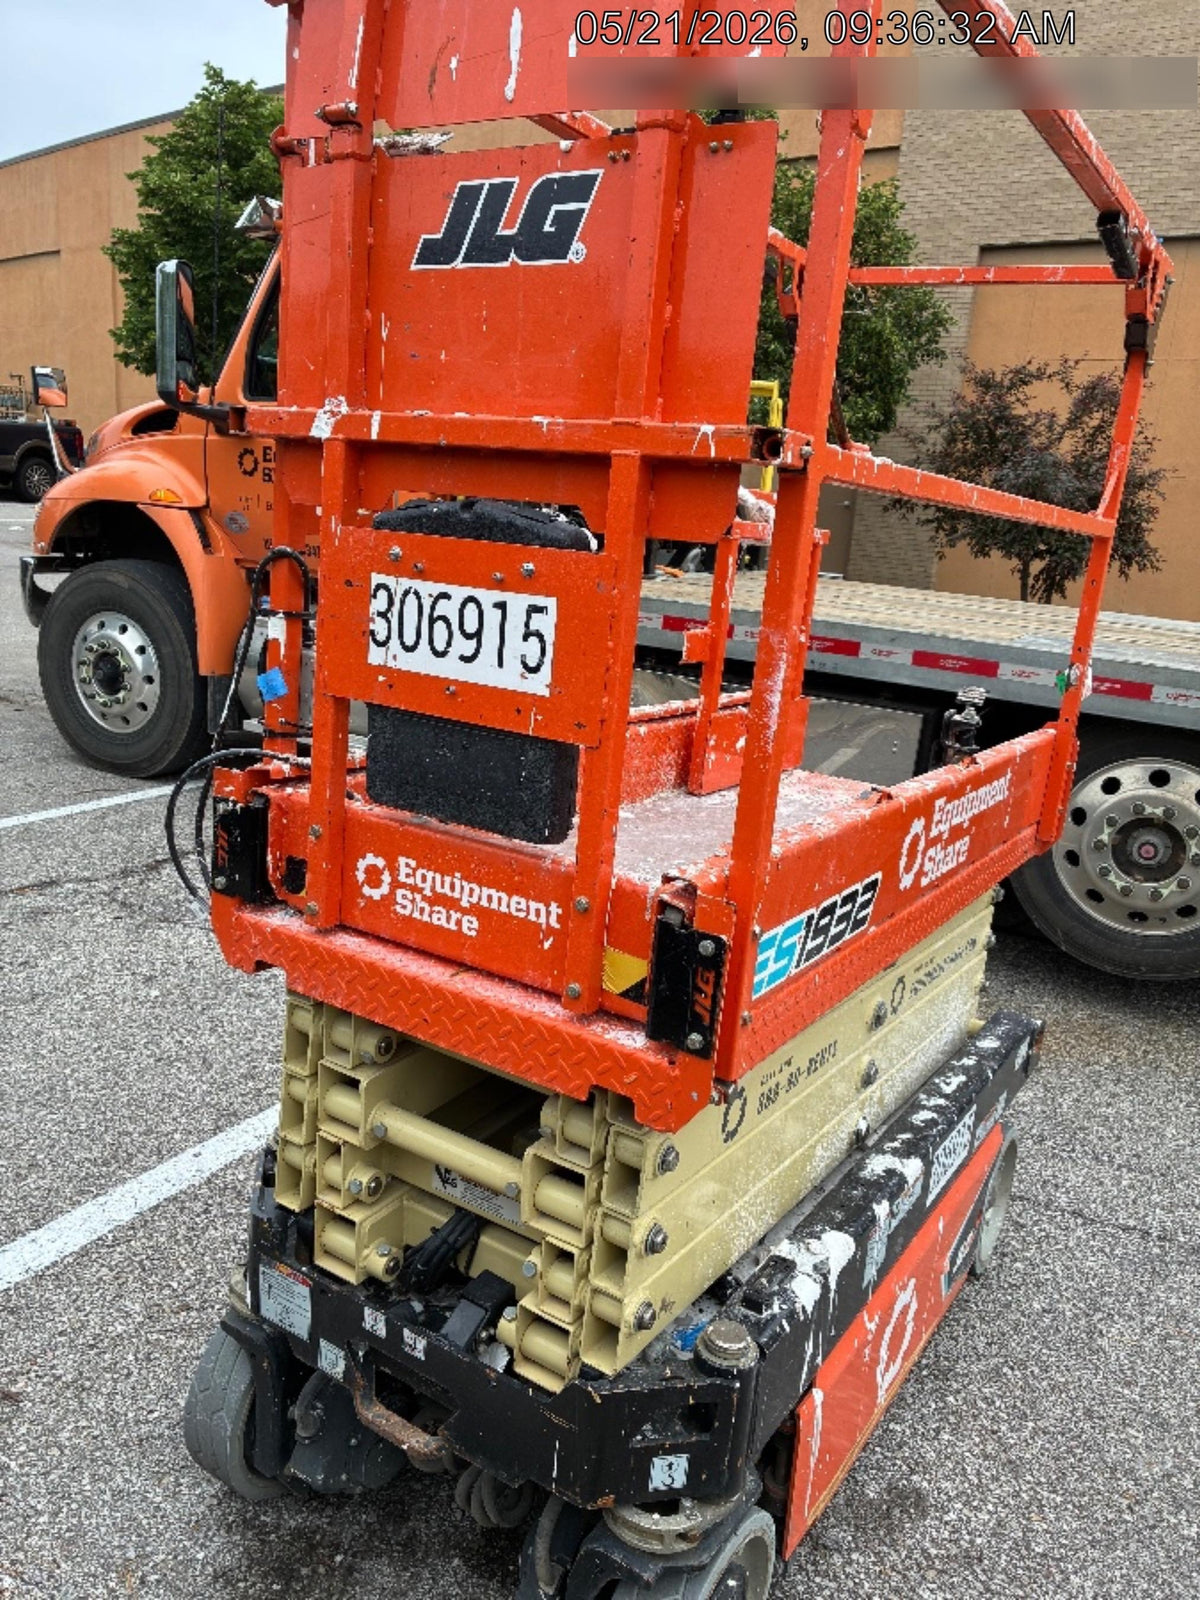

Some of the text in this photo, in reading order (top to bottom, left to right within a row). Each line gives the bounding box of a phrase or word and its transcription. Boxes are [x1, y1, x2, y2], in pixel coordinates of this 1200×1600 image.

[410, 169, 604, 269] JLG
[369, 582, 548, 675] 306915
[929, 770, 1012, 839] Equipment
[397, 856, 563, 929] Equipment
[920, 836, 970, 888] Share
[395, 888, 479, 937] Share
[693, 966, 715, 1026] JLG
